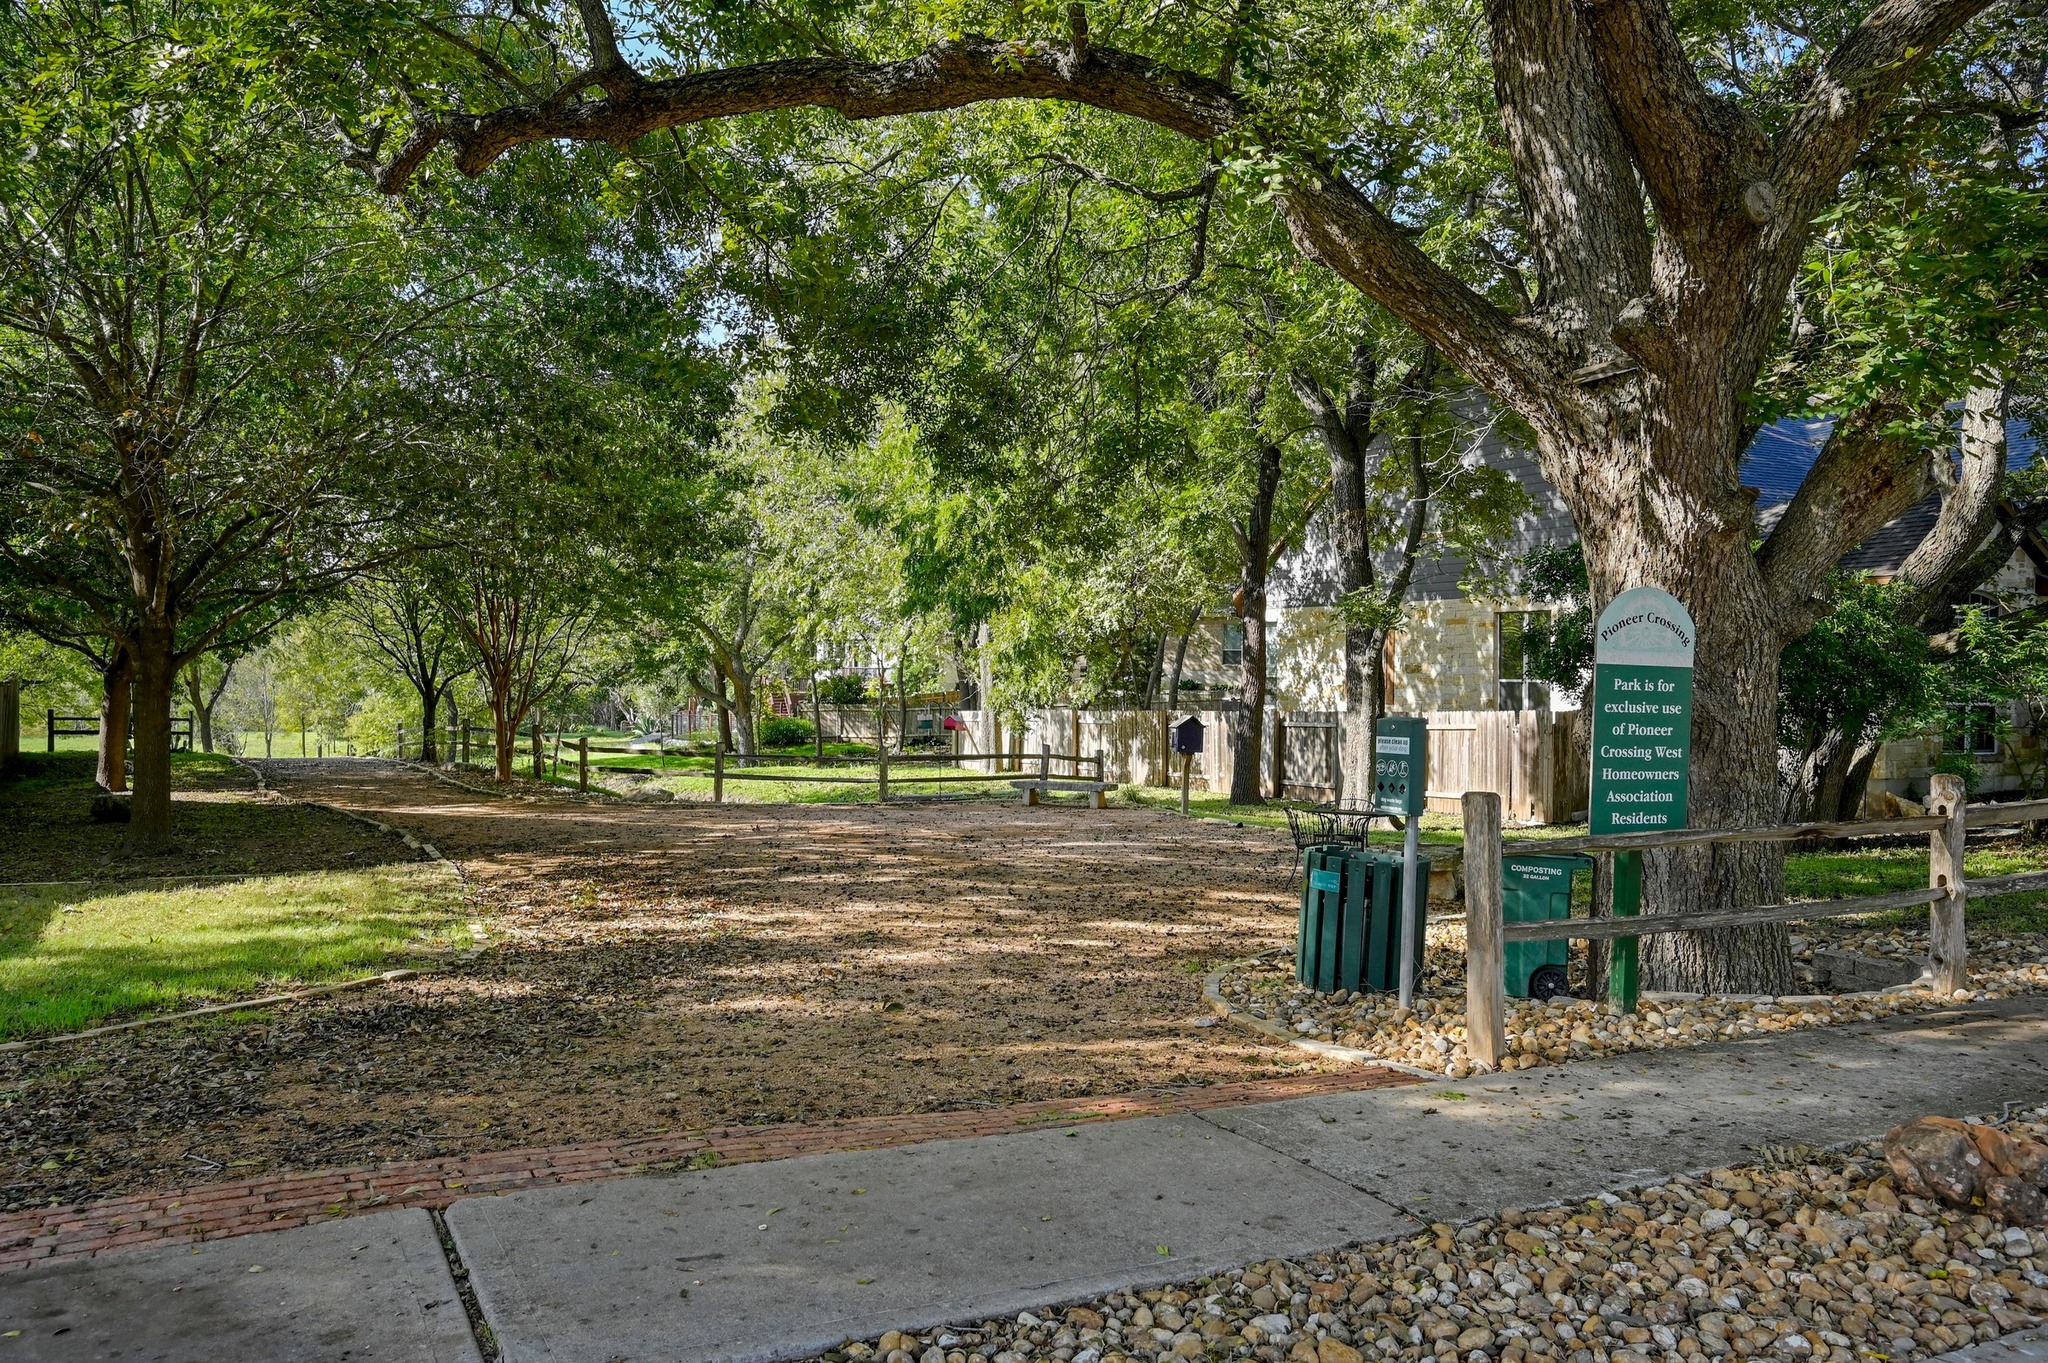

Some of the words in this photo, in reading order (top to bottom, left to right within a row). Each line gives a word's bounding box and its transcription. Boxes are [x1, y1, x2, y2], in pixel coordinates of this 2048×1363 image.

[1601, 614, 1644, 641] Pioneer
[1647, 612, 1690, 648] Crossing
[1614, 678, 1641, 691] Park
[1644, 680, 1654, 692] is
[1657, 679, 1675, 692] for
[1604, 701, 1659, 714] exclusive
[1662, 705, 1682, 715] use
[1612, 723, 1626, 735] of
[1628, 723, 1673, 736] Pioneer
[1600, 745, 1652, 761] Crossing
[1655, 746, 1682, 758] West
[1602, 768, 1680, 780] Homeowners
[1606, 790, 1673, 802] Association
[1611, 812, 1667, 824] Residents
[1511, 864, 1562, 875] COMPOSTING
